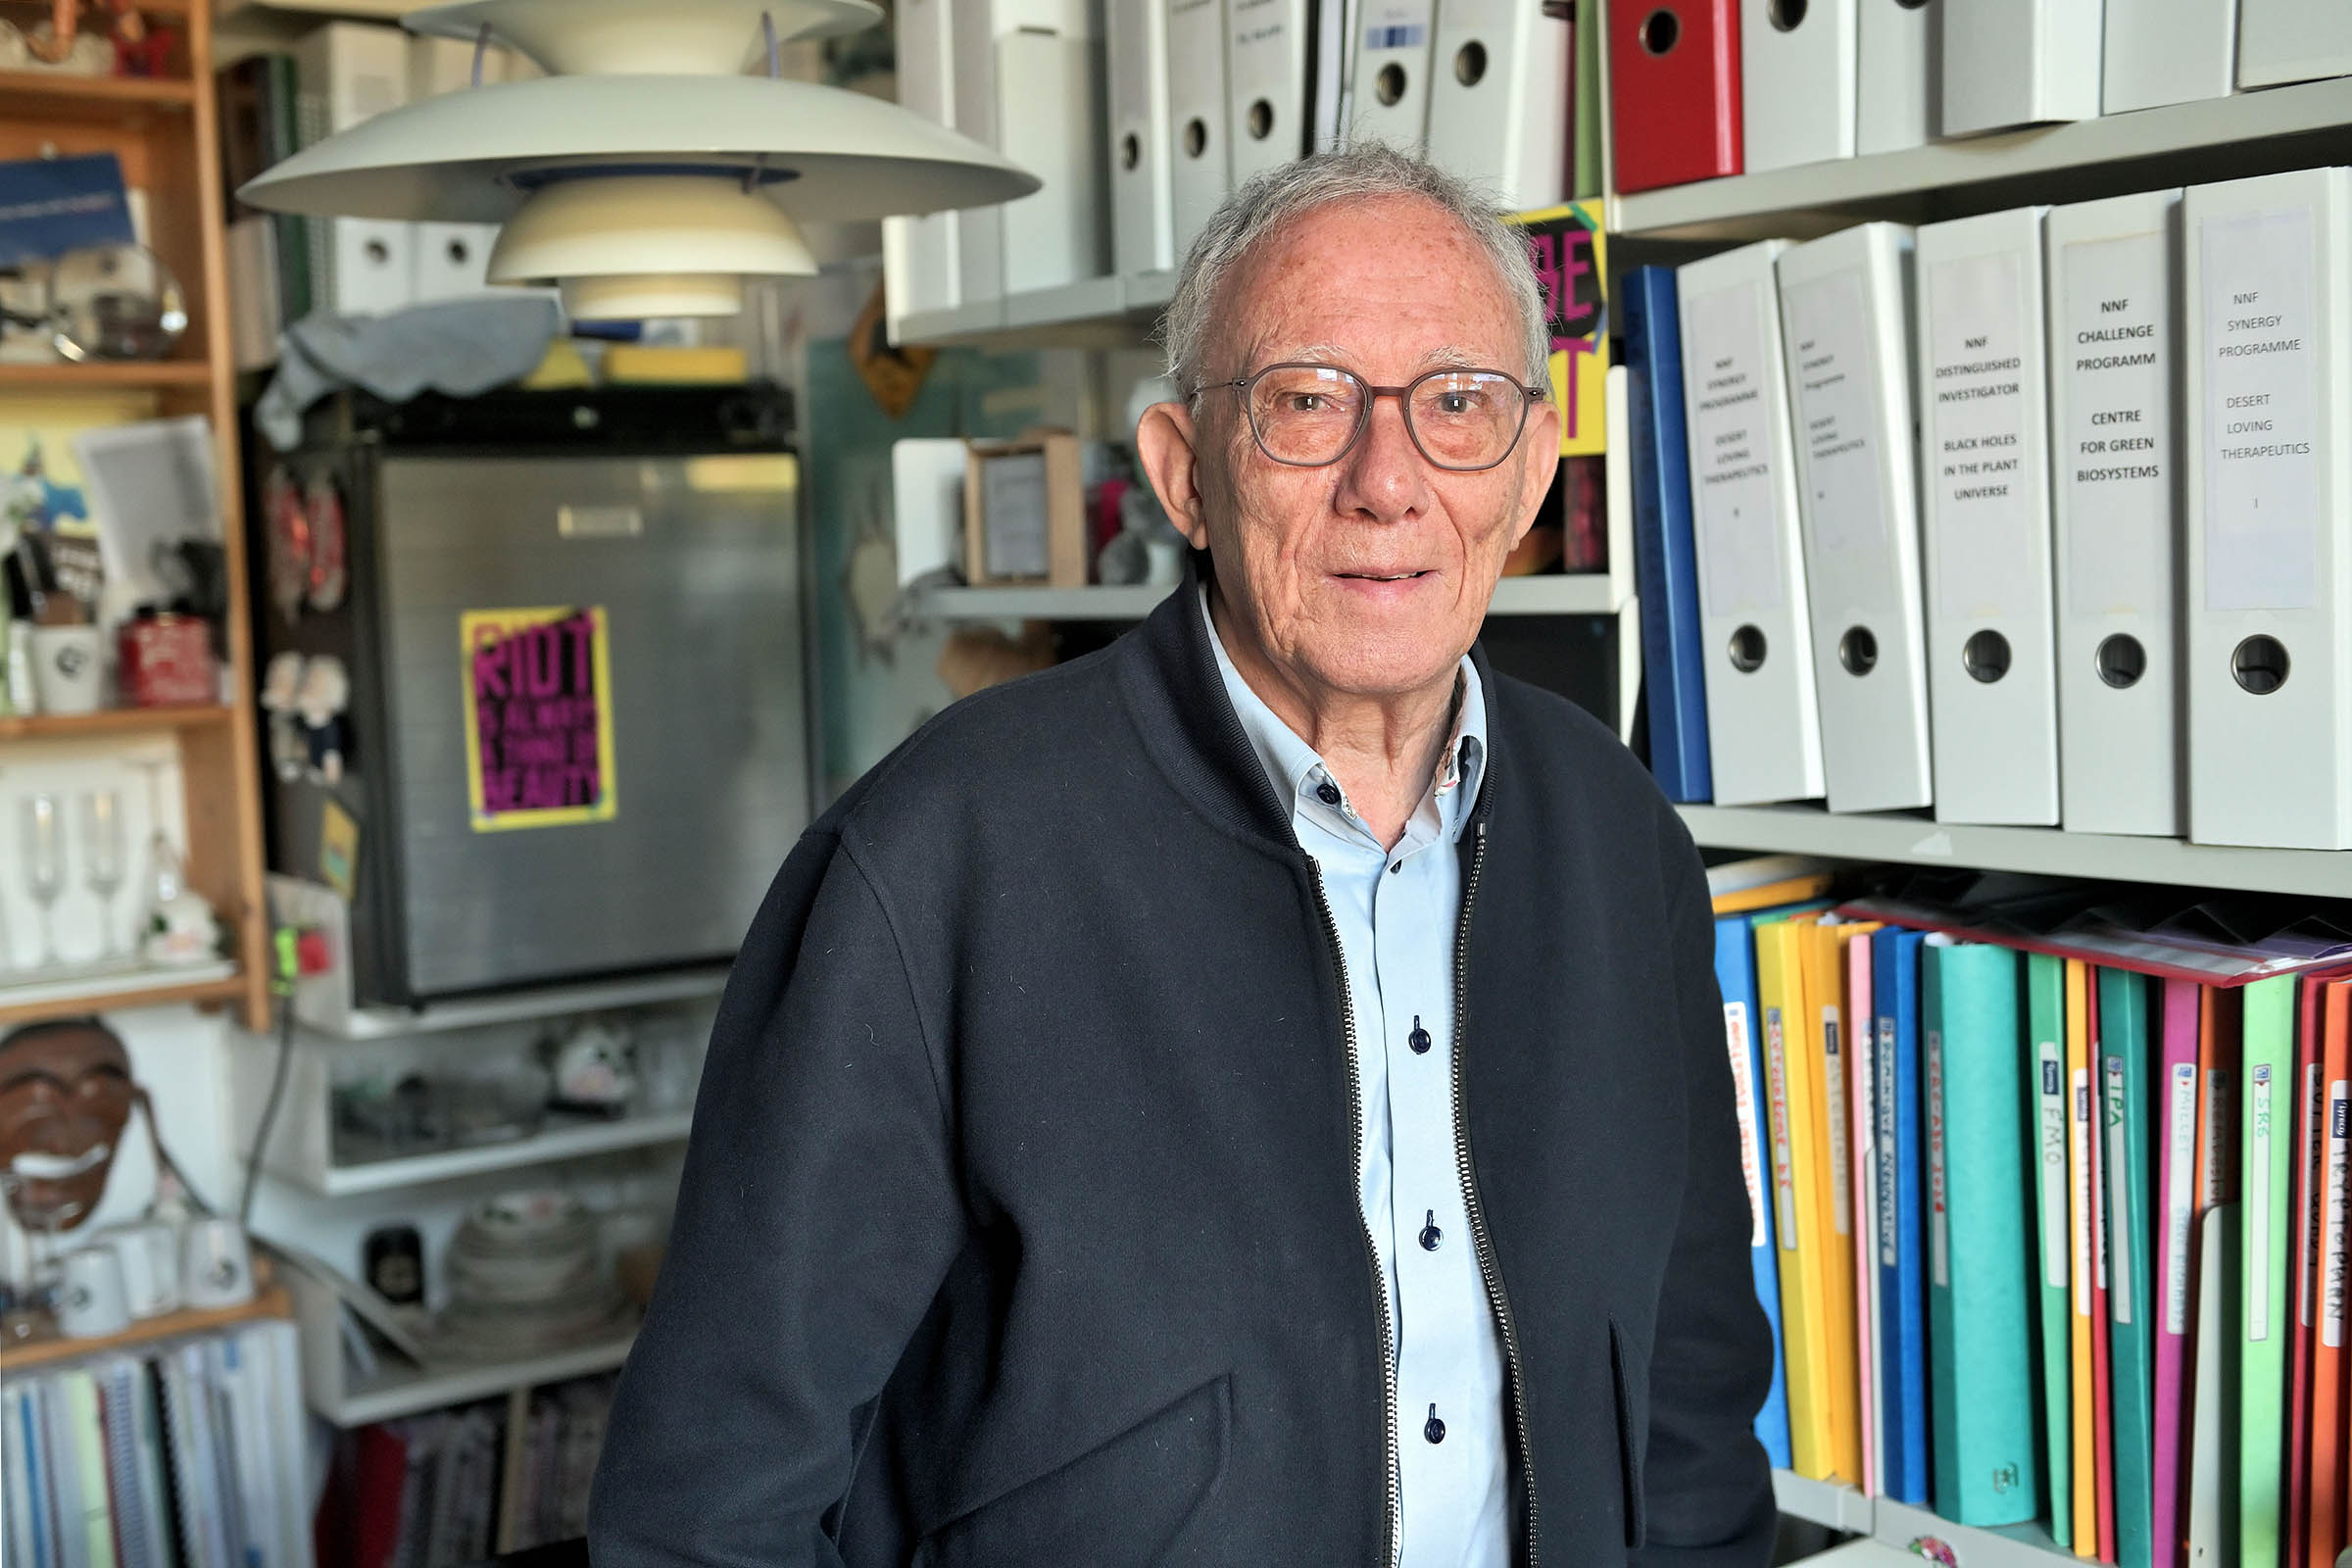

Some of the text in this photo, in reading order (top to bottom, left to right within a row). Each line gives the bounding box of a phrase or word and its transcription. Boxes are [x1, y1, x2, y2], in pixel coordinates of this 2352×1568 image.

[2101, 299, 2129, 313] NNF
[2233, 292, 2259, 305] NNF
[2228, 315, 2282, 331] SYNERGY
[2078, 324, 2155, 344] CHALLENGE
[1965, 336, 1988, 350] NNF
[2219, 339, 2301, 357] PROGRAMME
[1936, 358, 2021, 378] DISTINGUISHED
[2076, 352, 2156, 370] PROGRAMM
[1938, 383, 2020, 403] INVESTIGATOR
[2227, 394, 2271, 409] DESERT
[2091, 410, 2141, 425] CENTRE
[2227, 419, 2273, 434] LOVING
[1943, 434, 2017, 451] BLACK HOLES
[2080, 437, 2155, 455] FOR GREEN
[2221, 442, 2310, 460] THERAPEUTICS
[1944, 459, 2018, 476] IN THE PLANT
[2077, 465, 2159, 481] BIOSYSTEMS
[1954, 485, 2009, 500] UNIVERSE
[473, 608, 596, 698] RIOT
[2043, 1106, 2064, 1165] FMO
